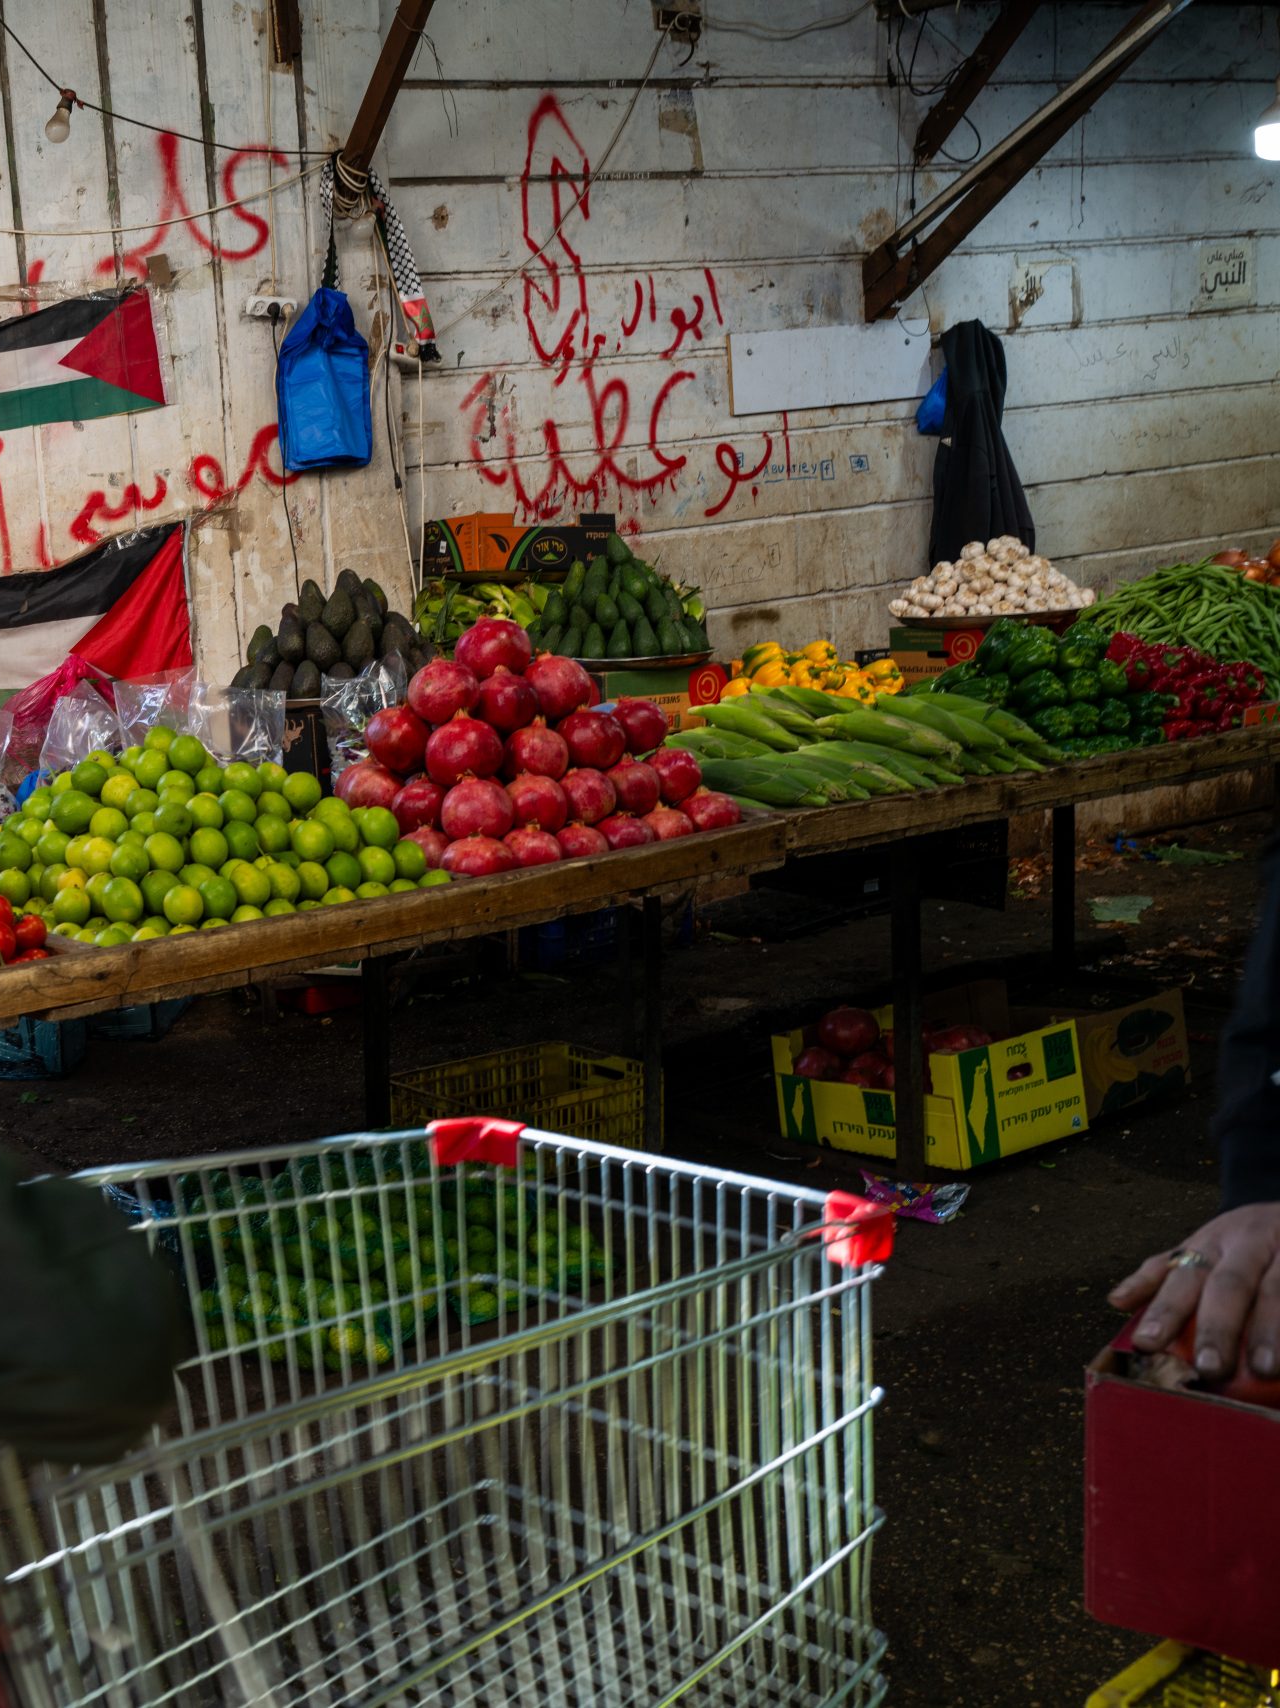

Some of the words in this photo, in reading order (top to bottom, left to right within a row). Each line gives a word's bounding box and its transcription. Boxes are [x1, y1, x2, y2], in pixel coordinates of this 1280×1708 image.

[1206, 249, 1223, 265] على
[1204, 260, 1247, 300] النبي
[535, 540, 549, 553] אור
[551, 539, 564, 552] פרי
[1030, 1104, 1052, 1122] עמק
[1055, 1095, 1081, 1114] משקי
[832, 1120, 864, 1135] הירדן
[1001, 1112, 1028, 1132] הירדן
